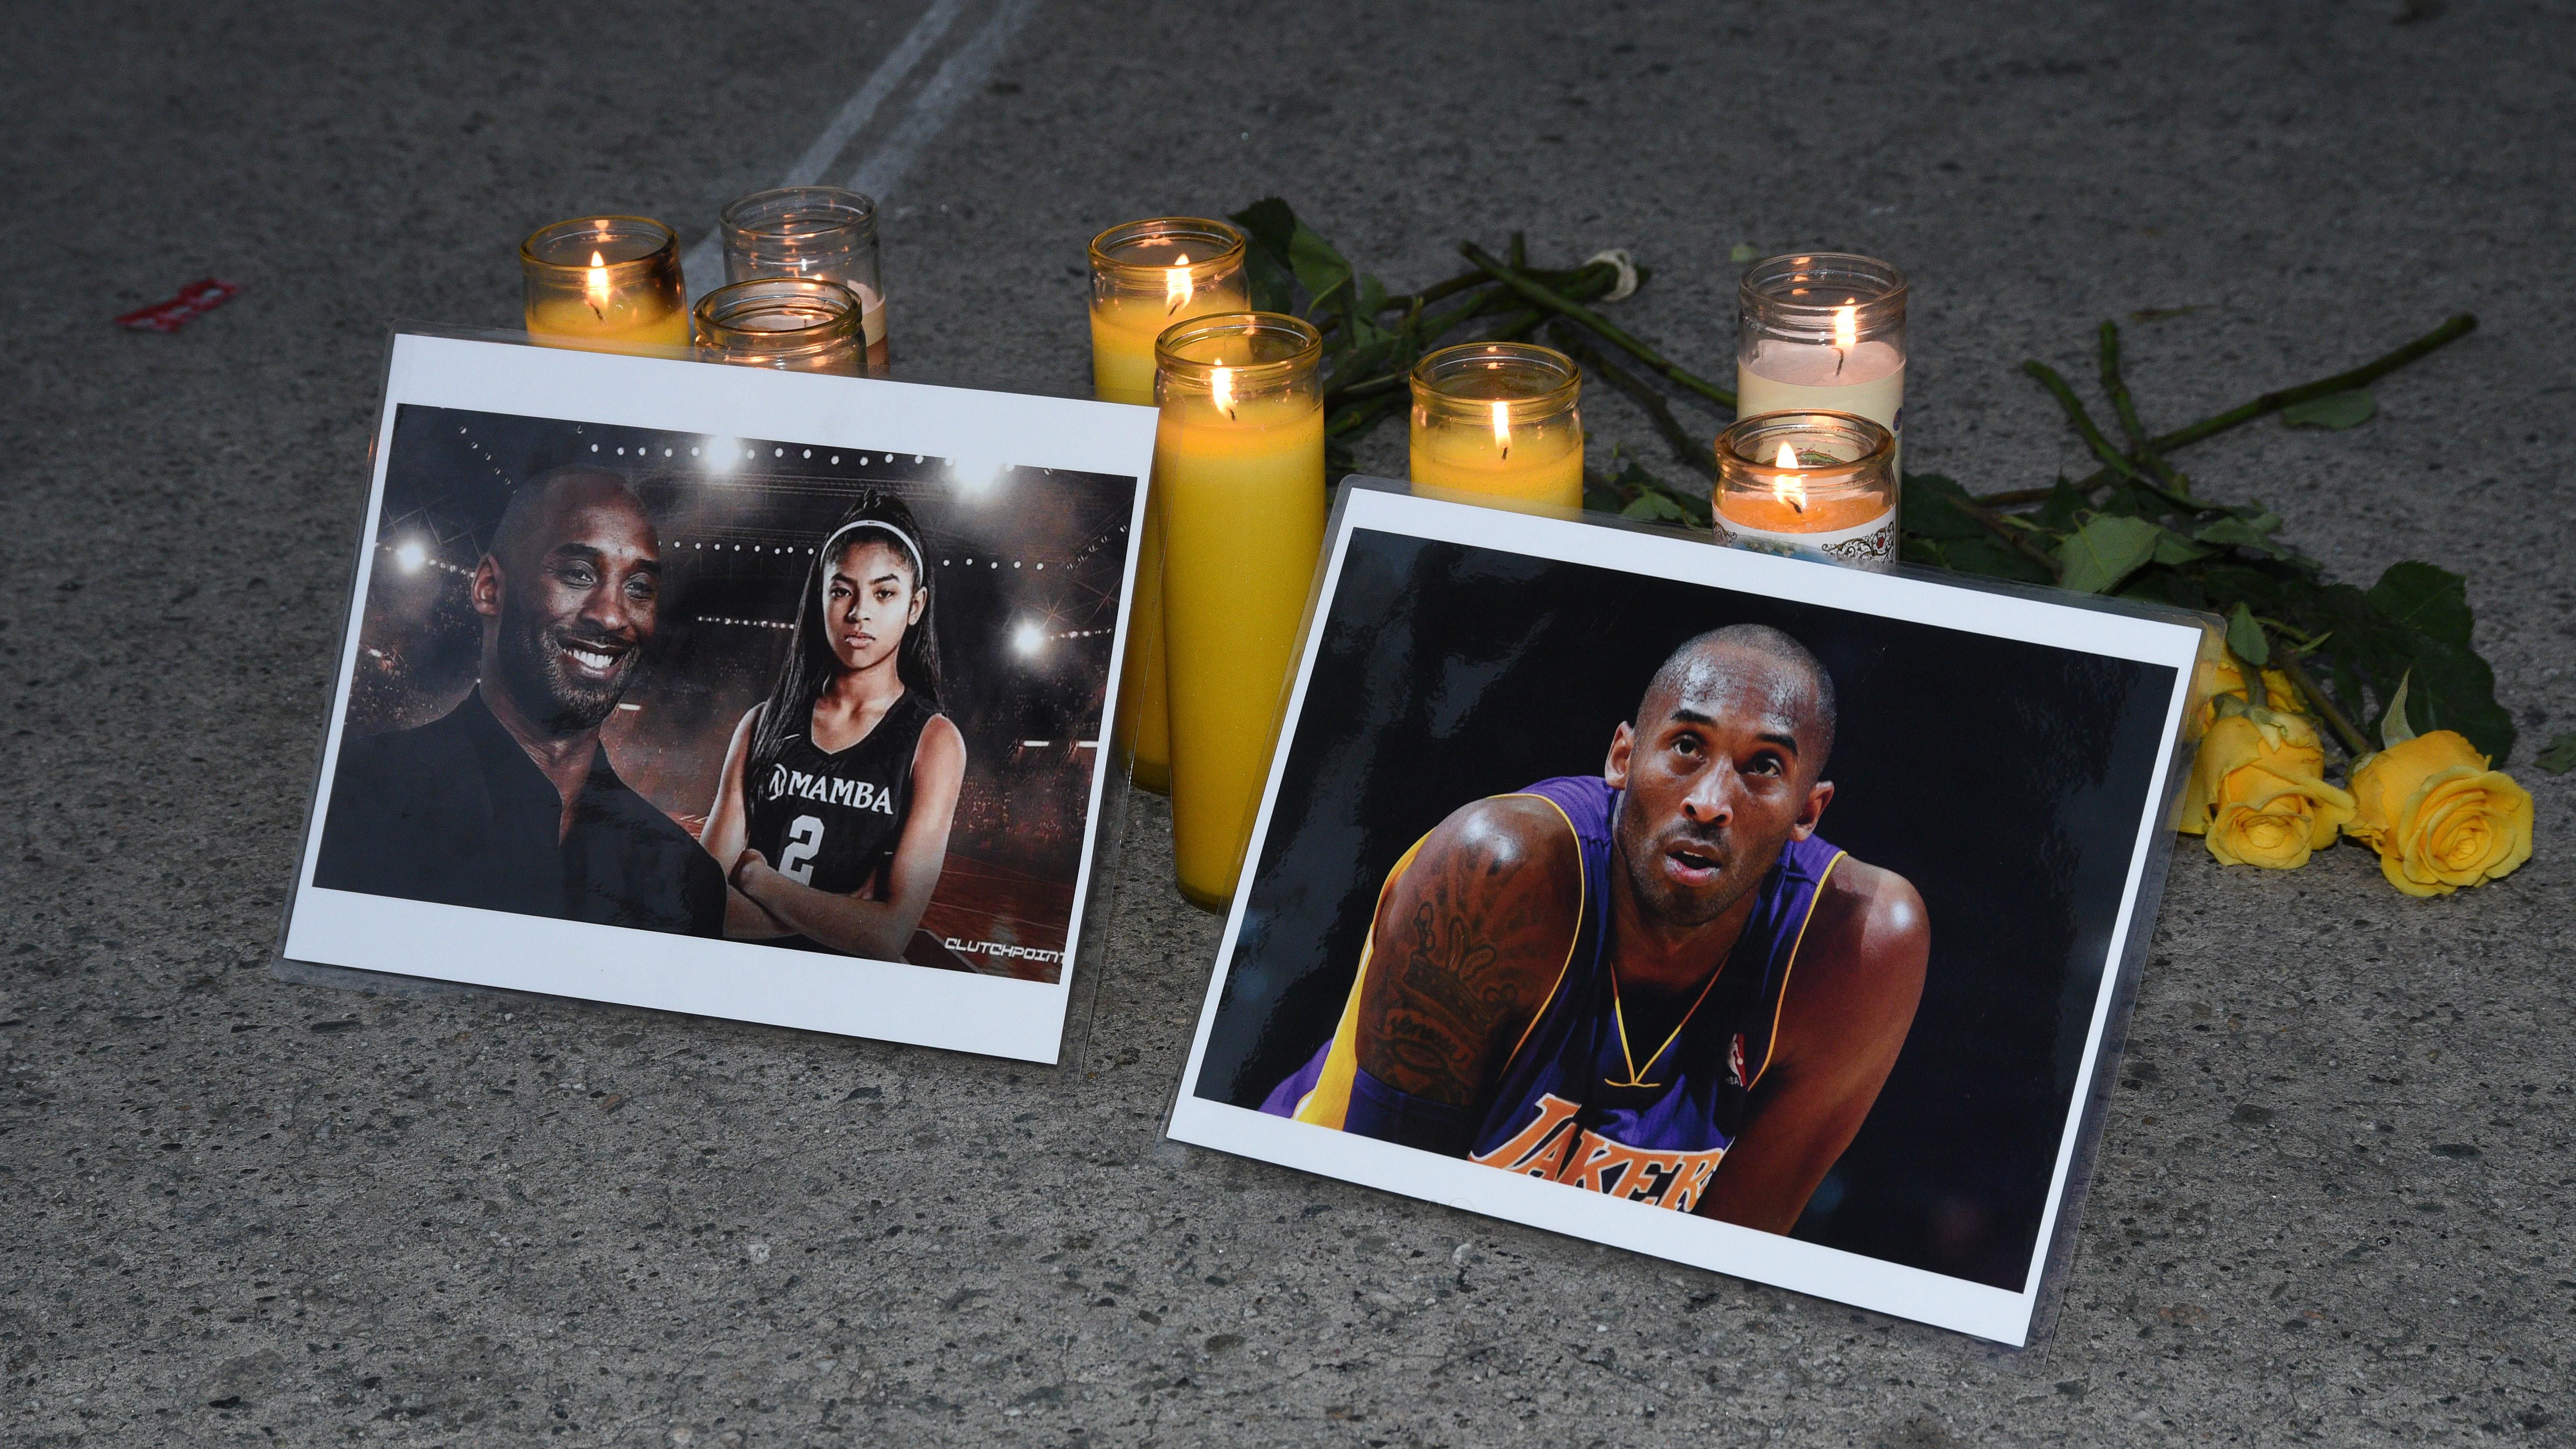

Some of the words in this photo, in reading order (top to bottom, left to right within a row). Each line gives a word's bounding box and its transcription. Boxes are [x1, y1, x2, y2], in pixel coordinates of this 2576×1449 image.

[788, 770, 893, 815] MAMBA
[779, 815, 825, 887] 2
[1467, 1092, 1724, 1213] LAKER
